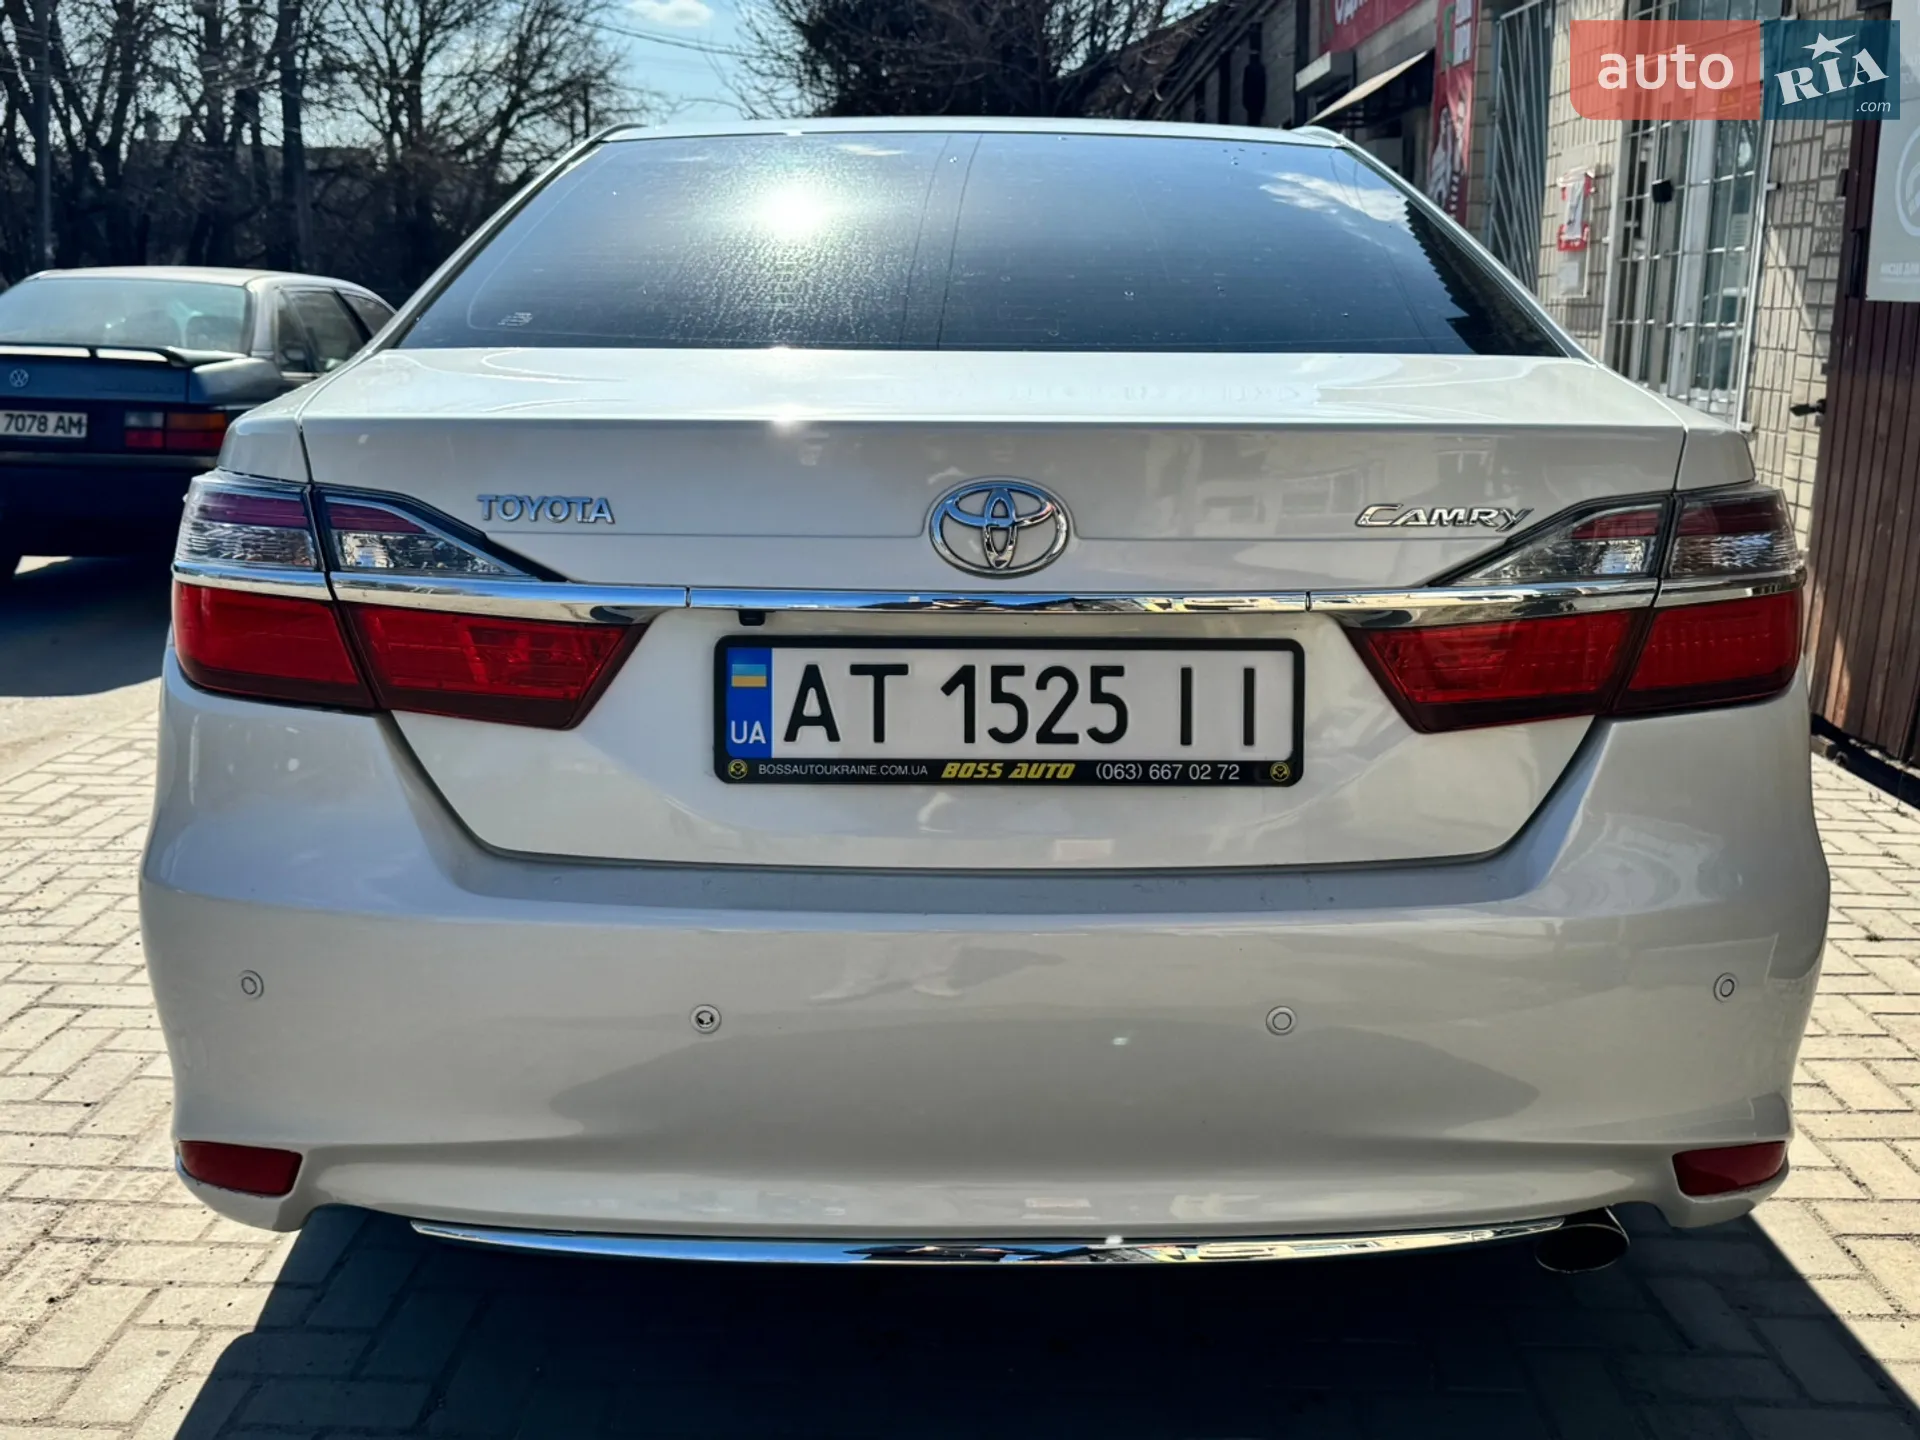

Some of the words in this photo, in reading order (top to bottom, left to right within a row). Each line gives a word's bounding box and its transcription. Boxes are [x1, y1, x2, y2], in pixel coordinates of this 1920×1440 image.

[3, 413, 48, 434] 7078
[54, 415, 83, 435] AM
[477, 494, 615, 524] TOYOTA
[1355, 503, 1534, 533] CAMRY
[783, 663, 909, 744] AT
[940, 664, 1128, 744] 1525
[730, 720, 767, 744] UA
[758, 763, 928, 776] BOSSAUTOUKRAINE.COM.UA
[941, 762, 1003, 779] BOSS
[1008, 762, 1076, 779] AUTO
[1095, 763, 1143, 781] (063)
[1149, 763, 1182, 780] 667
[1188, 763, 1211, 780] 02
[1217, 763, 1240, 780] 72
